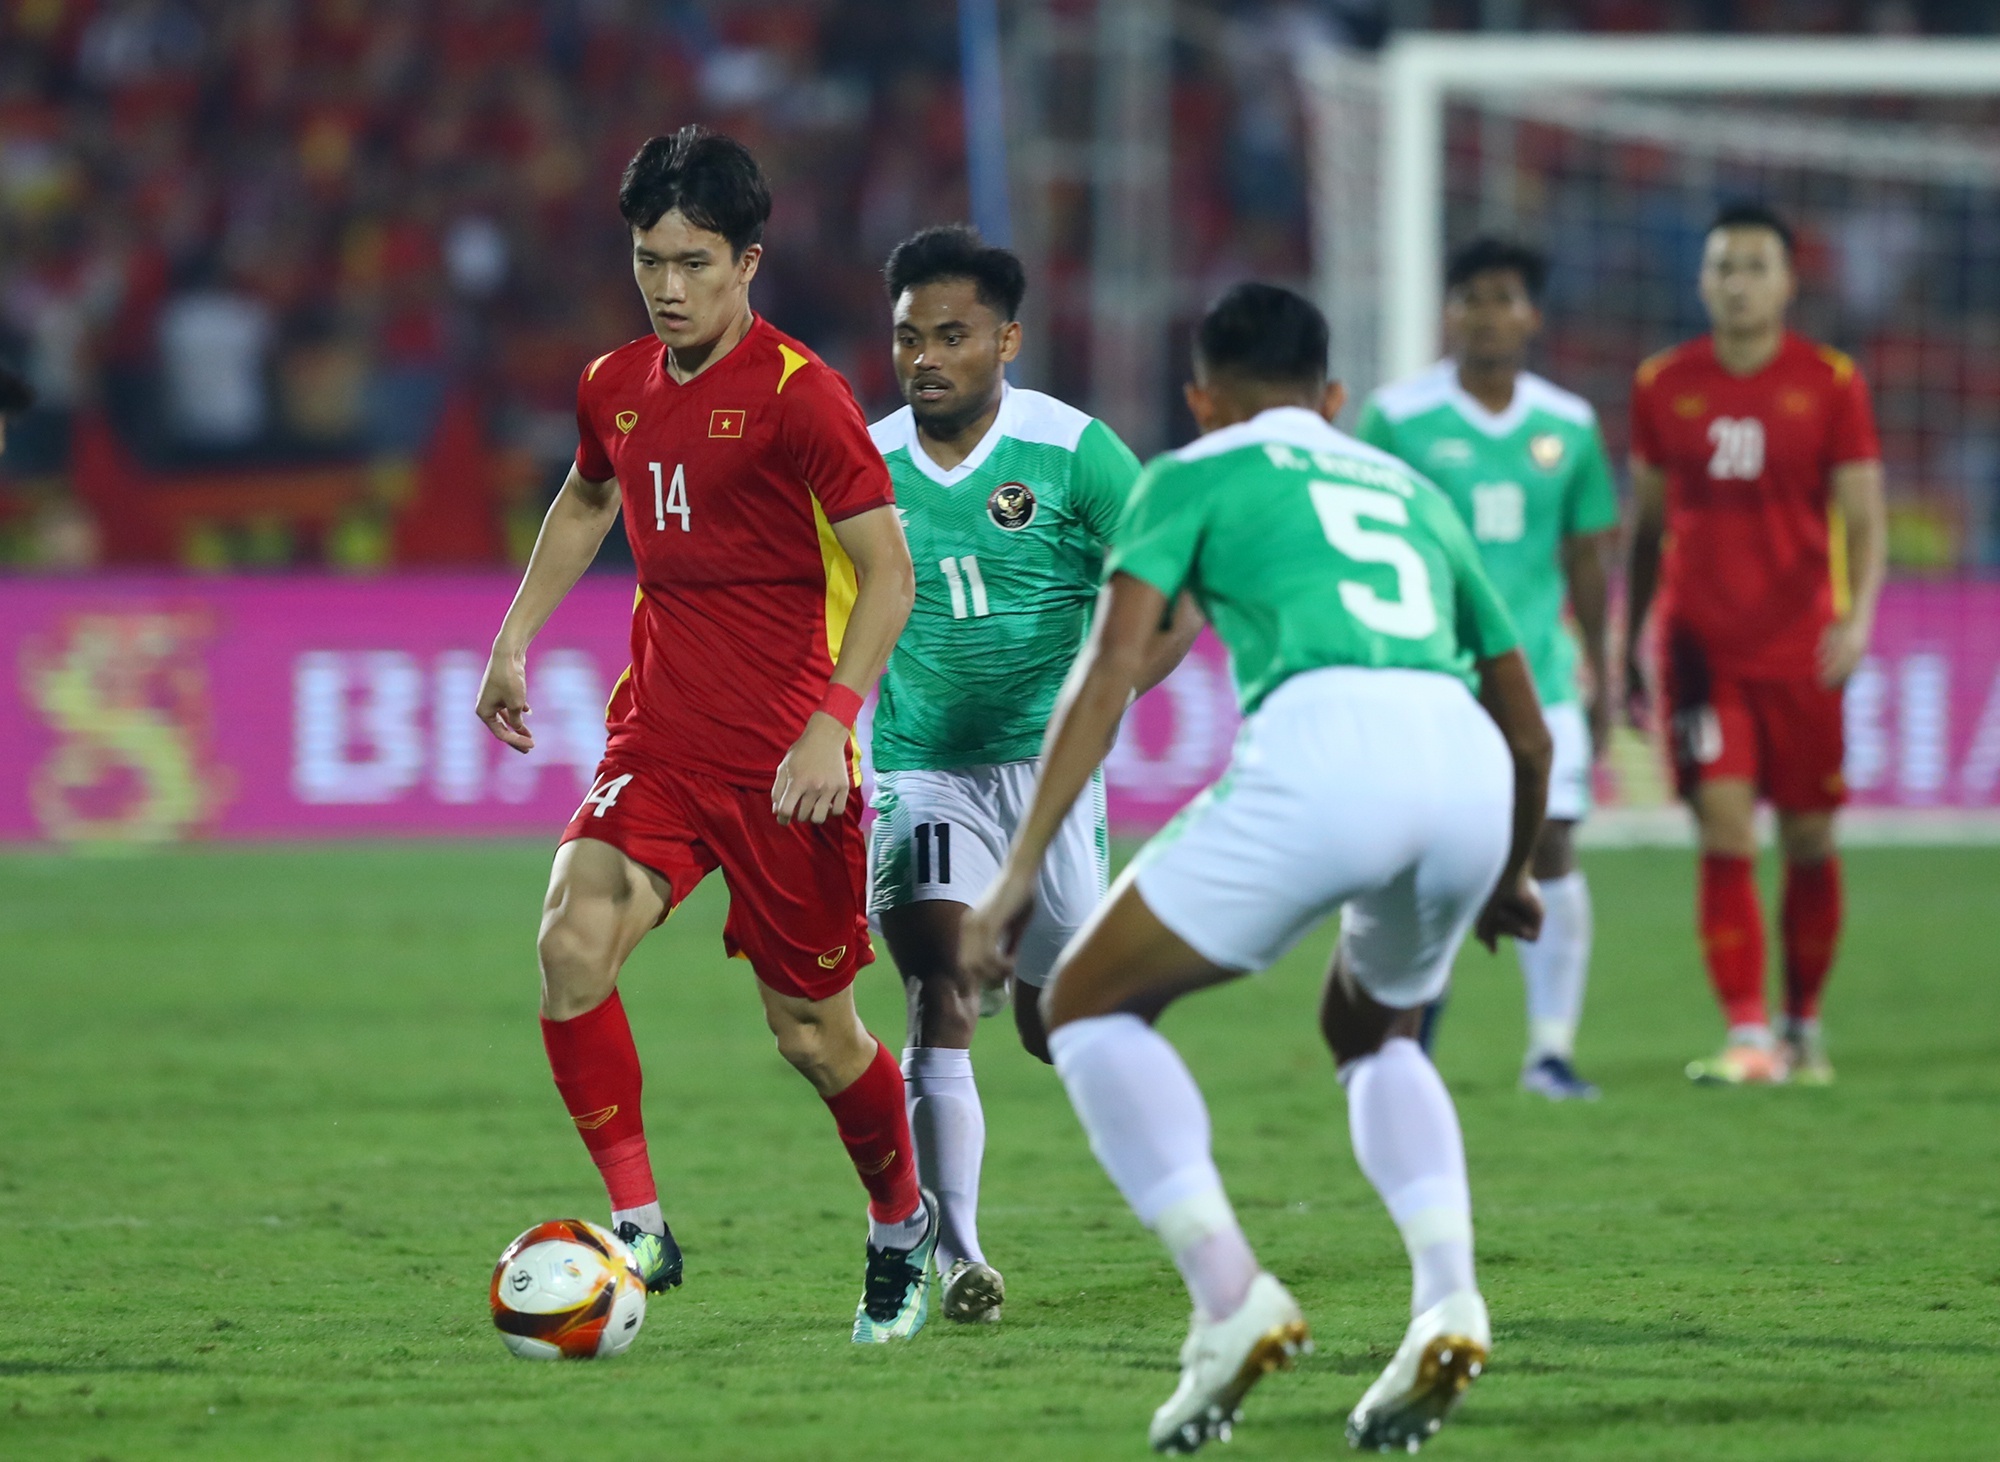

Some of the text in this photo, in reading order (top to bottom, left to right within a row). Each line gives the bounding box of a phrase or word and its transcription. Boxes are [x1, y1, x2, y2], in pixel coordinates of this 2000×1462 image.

[1707, 416, 1766, 479] 20
[648, 461, 691, 532] 14
[939, 555, 989, 619] 11
[1308, 481, 1436, 640] 5
[295, 650, 607, 803] BIA
[915, 822, 950, 884] 11
